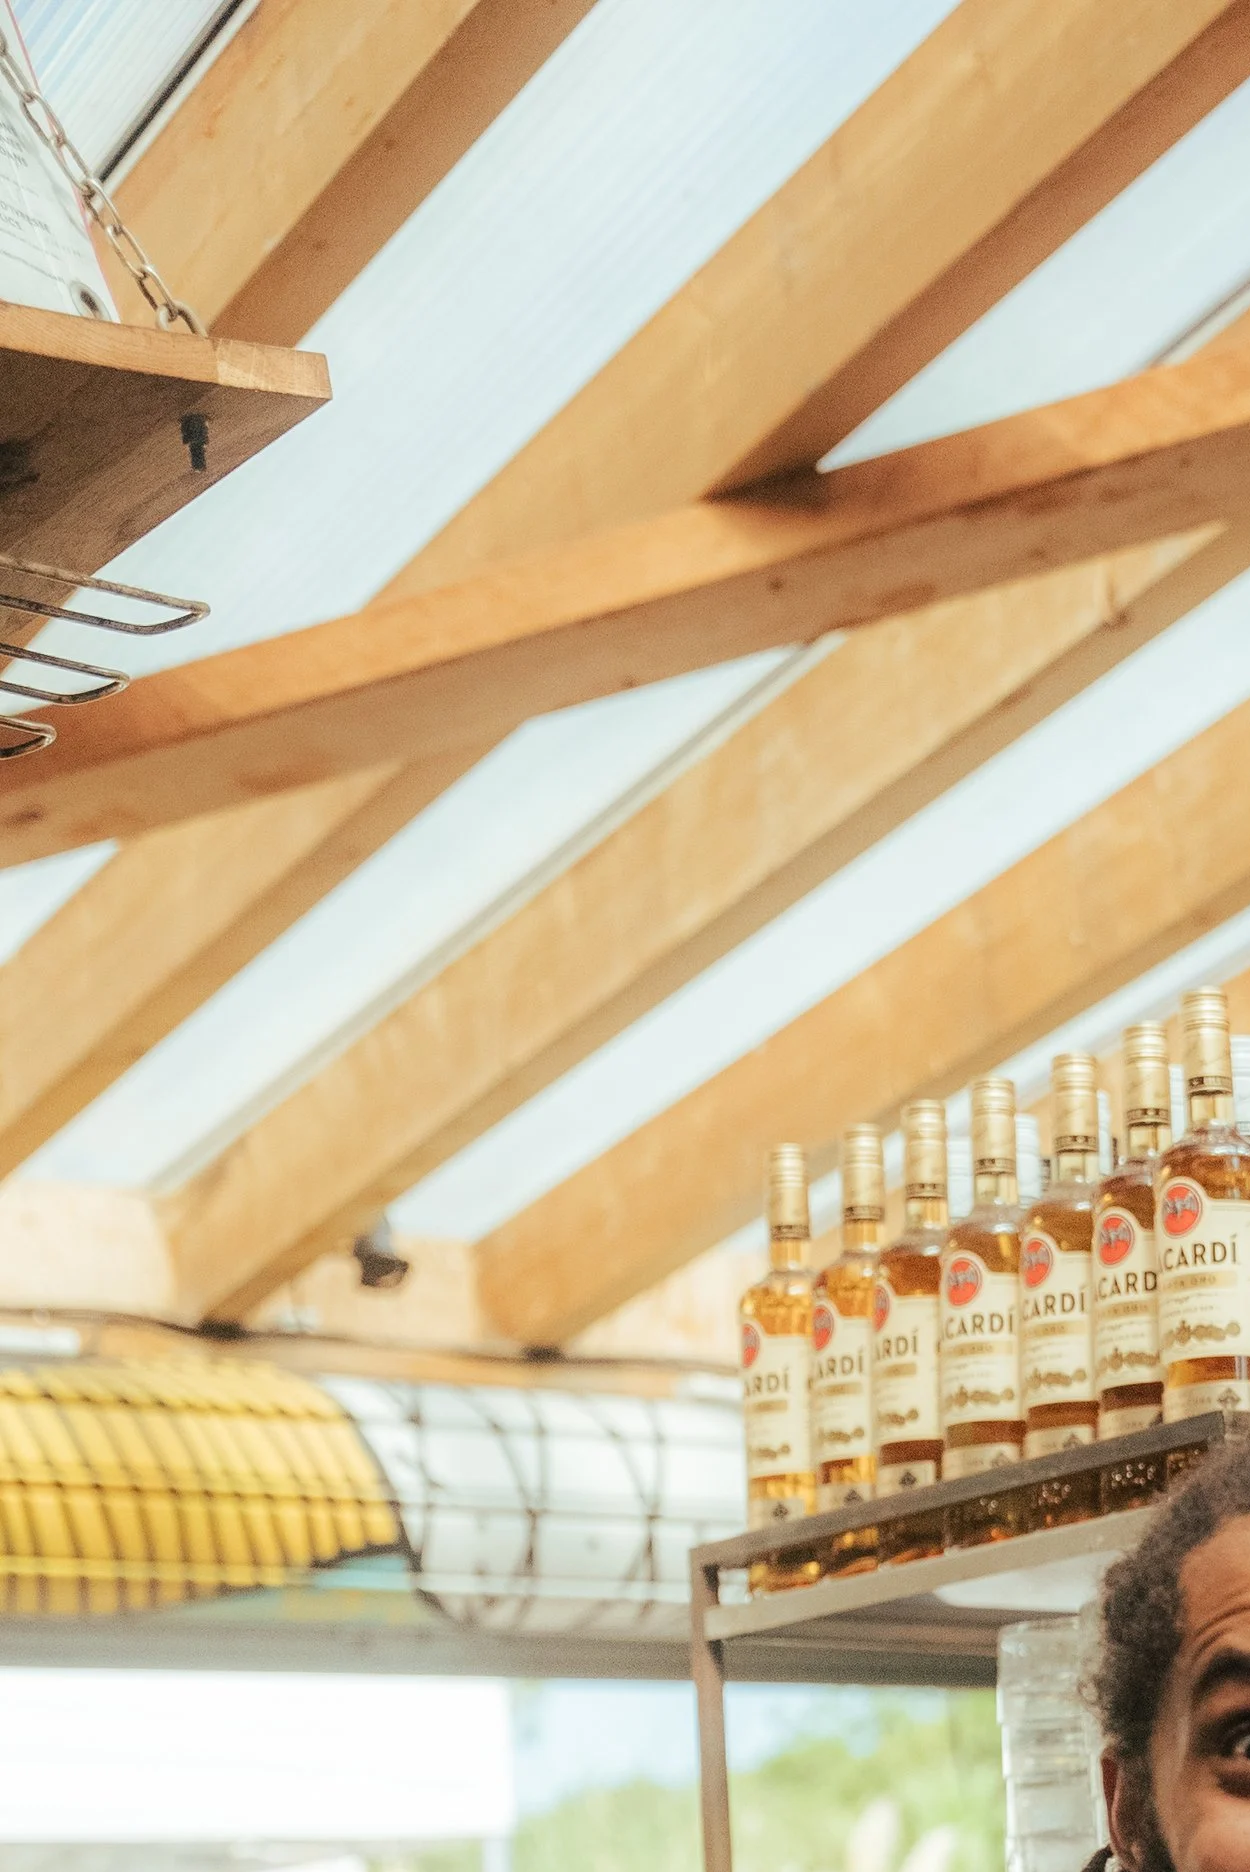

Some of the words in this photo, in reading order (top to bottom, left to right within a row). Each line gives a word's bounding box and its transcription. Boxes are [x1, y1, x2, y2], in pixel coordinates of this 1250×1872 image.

[1158, 1233, 1239, 1274] CARDÍ
[1097, 1270, 1158, 1299] CARD
[1022, 1286, 1087, 1321] CARDÍ
[943, 1307, 1015, 1340] CARDÍ
